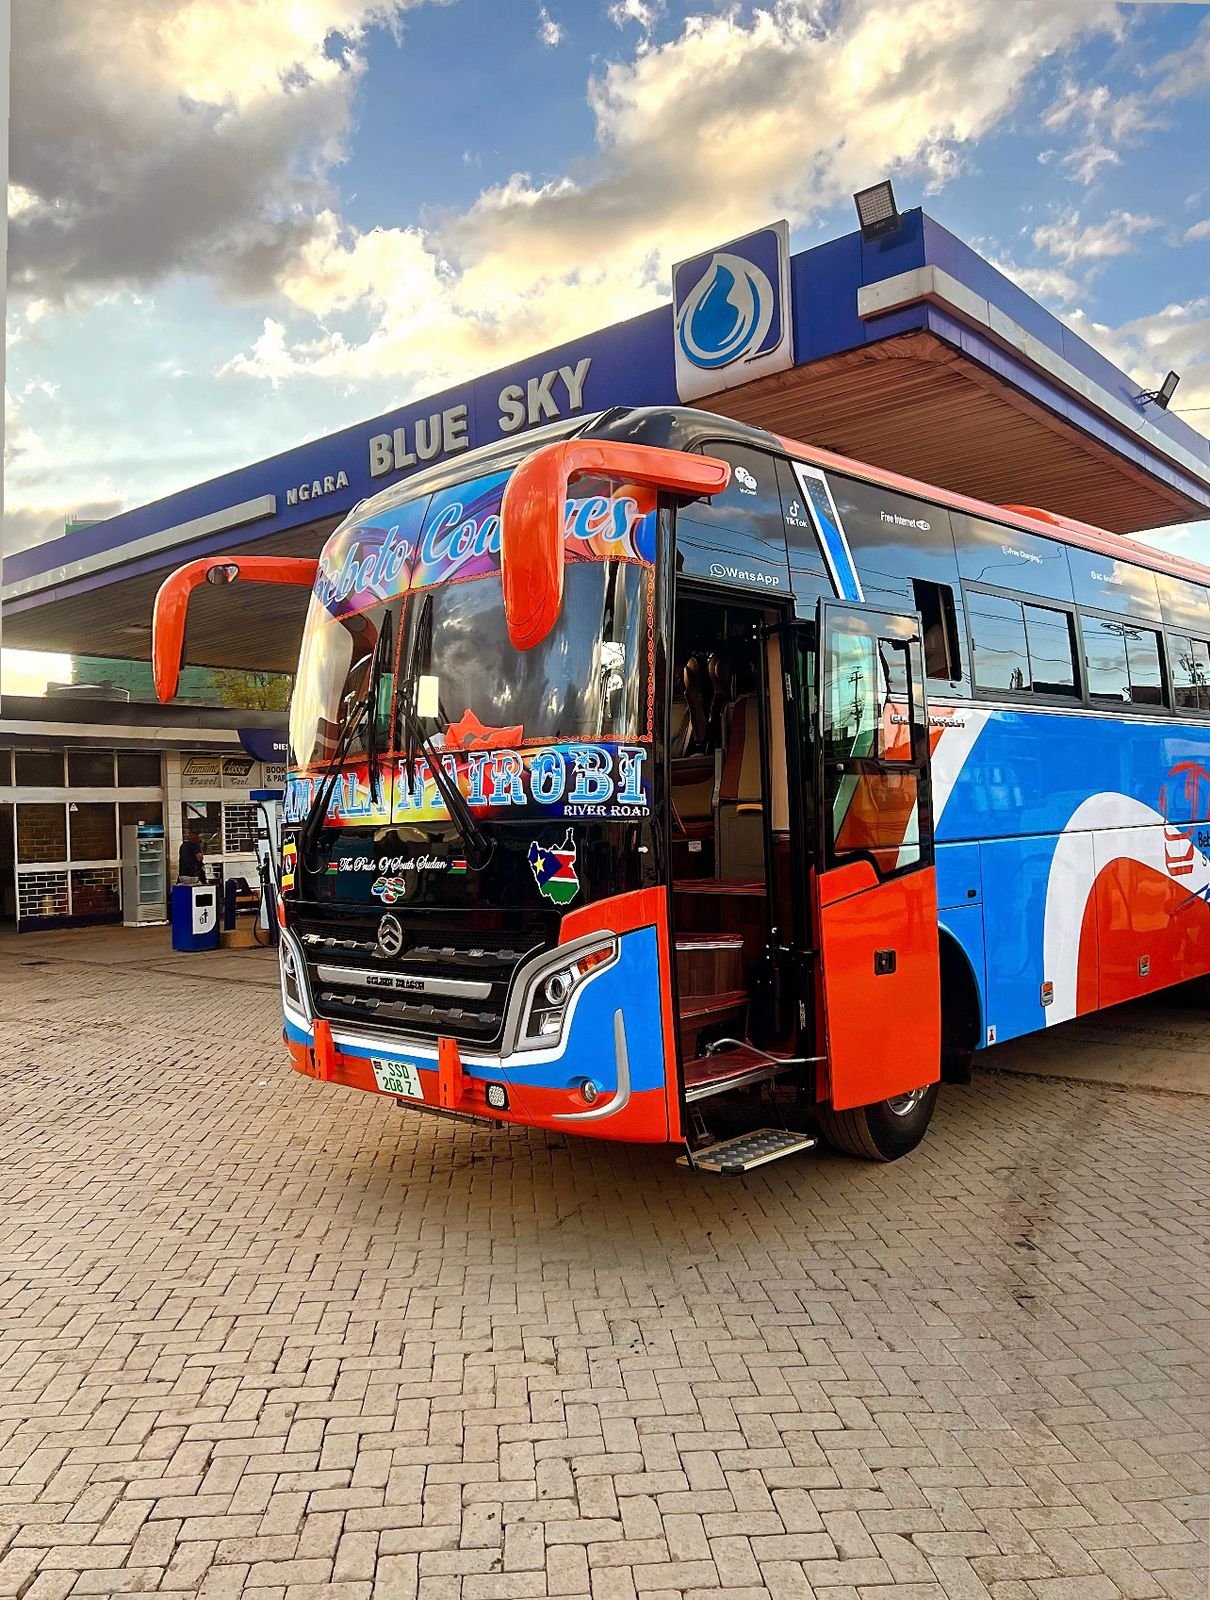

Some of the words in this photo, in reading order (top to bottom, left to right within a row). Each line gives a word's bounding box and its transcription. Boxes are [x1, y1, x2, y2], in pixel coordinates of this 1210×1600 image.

[287, 470, 349, 506] NGARA
[369, 404, 469, 477] BLUE
[498, 357, 592, 432] SKY
[785, 516, 808, 528] TikTok
[880, 510, 893, 523] Free
[894, 514, 916, 528] Internet
[725, 566, 779, 586] WatsApp
[564, 804, 607, 816] RIVER
[611, 804, 650, 817] ROAD
[339, 857, 352, 872] The
[378, 856, 392, 875] Of
[391, 855, 415, 874] South
[416, 854, 447, 872] Sudan
[387, 1062, 409, 1079] SSD
[407, 1081, 414, 1095] Z
